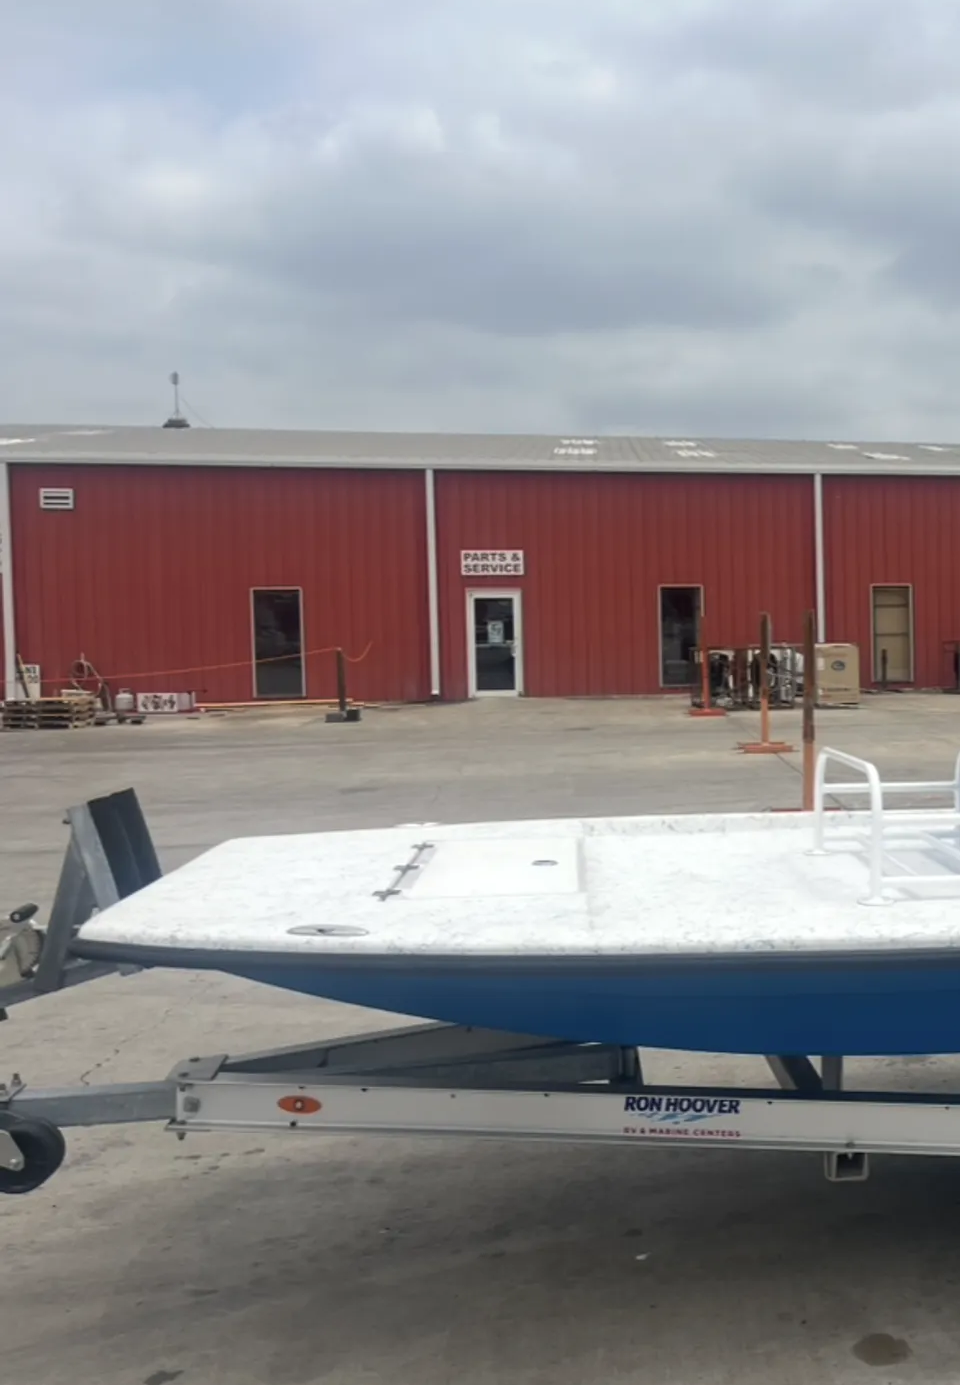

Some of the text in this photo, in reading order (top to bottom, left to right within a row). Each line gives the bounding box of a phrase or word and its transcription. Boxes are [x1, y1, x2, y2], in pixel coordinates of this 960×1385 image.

[463, 552, 520, 562] PARTS &
[464, 563, 521, 574] SERVICE
[624, 1096, 741, 1114] RON HOOVER
